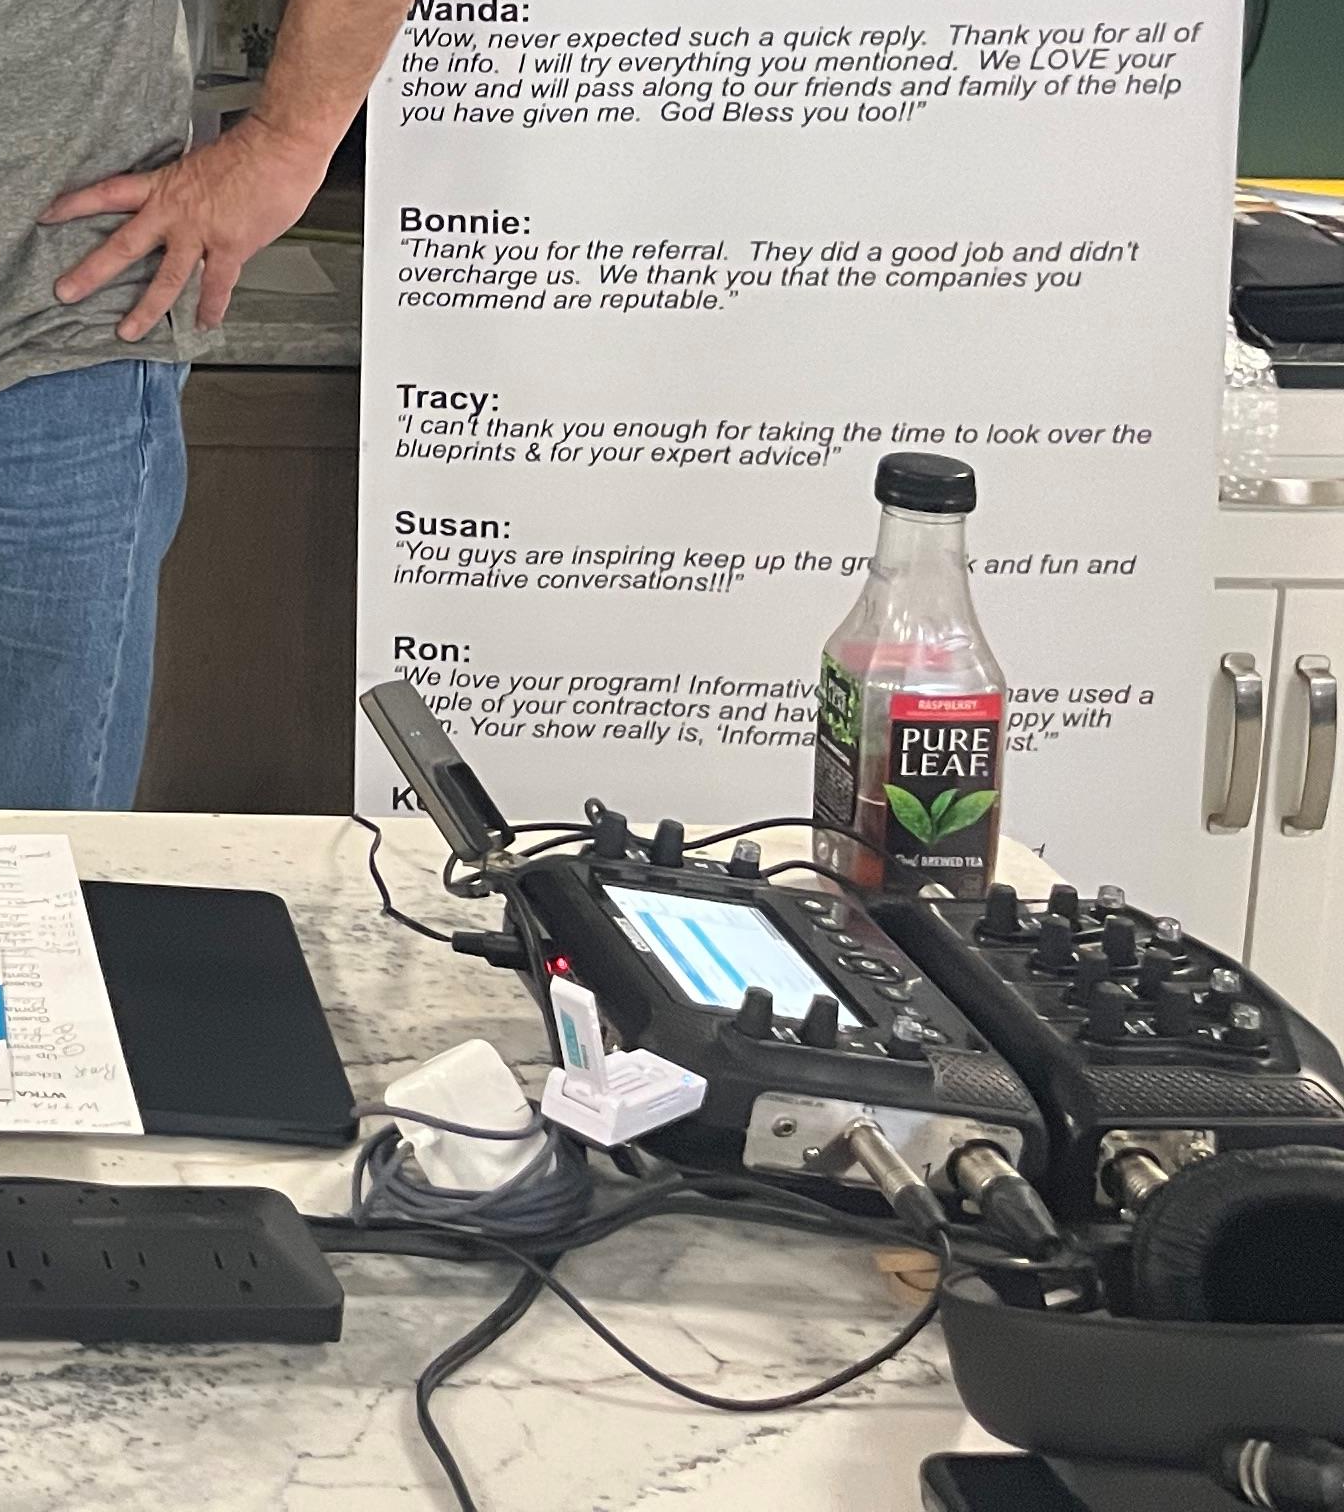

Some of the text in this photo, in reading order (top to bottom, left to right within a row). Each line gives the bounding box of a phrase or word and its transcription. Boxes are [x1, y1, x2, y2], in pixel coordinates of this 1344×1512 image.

[400, 107, 445, 127] you
[453, 103, 514, 123] have
[522, 103, 588, 128] given
[597, 107, 640, 122] me.
[661, 101, 714, 122] God
[723, 102, 794, 122] Bless
[801, 107, 848, 128] you
[401, 207, 530, 234] Bonnie:
[398, 290, 546, 309] recommend
[553, 294, 592, 309] are
[396, 384, 499, 421] Tracy:
[395, 439, 516, 464] blueprints
[525, 442, 541, 462] &
[549, 441, 584, 463] for
[588, 447, 644, 467] your
[651, 446, 731, 468] expert
[395, 511, 510, 539] Susan:
[394, 563, 529, 590] informative
[394, 636, 470, 663] Ron:
[918, 699, 979, 711] RASPBERRY
[470, 716, 703, 746] Your show really is,
[901, 727, 991, 752] PURE
[899, 752, 989, 777] LEAF
[921, 855, 962, 868] BREWED
[965, 856, 984, 868] TEA
